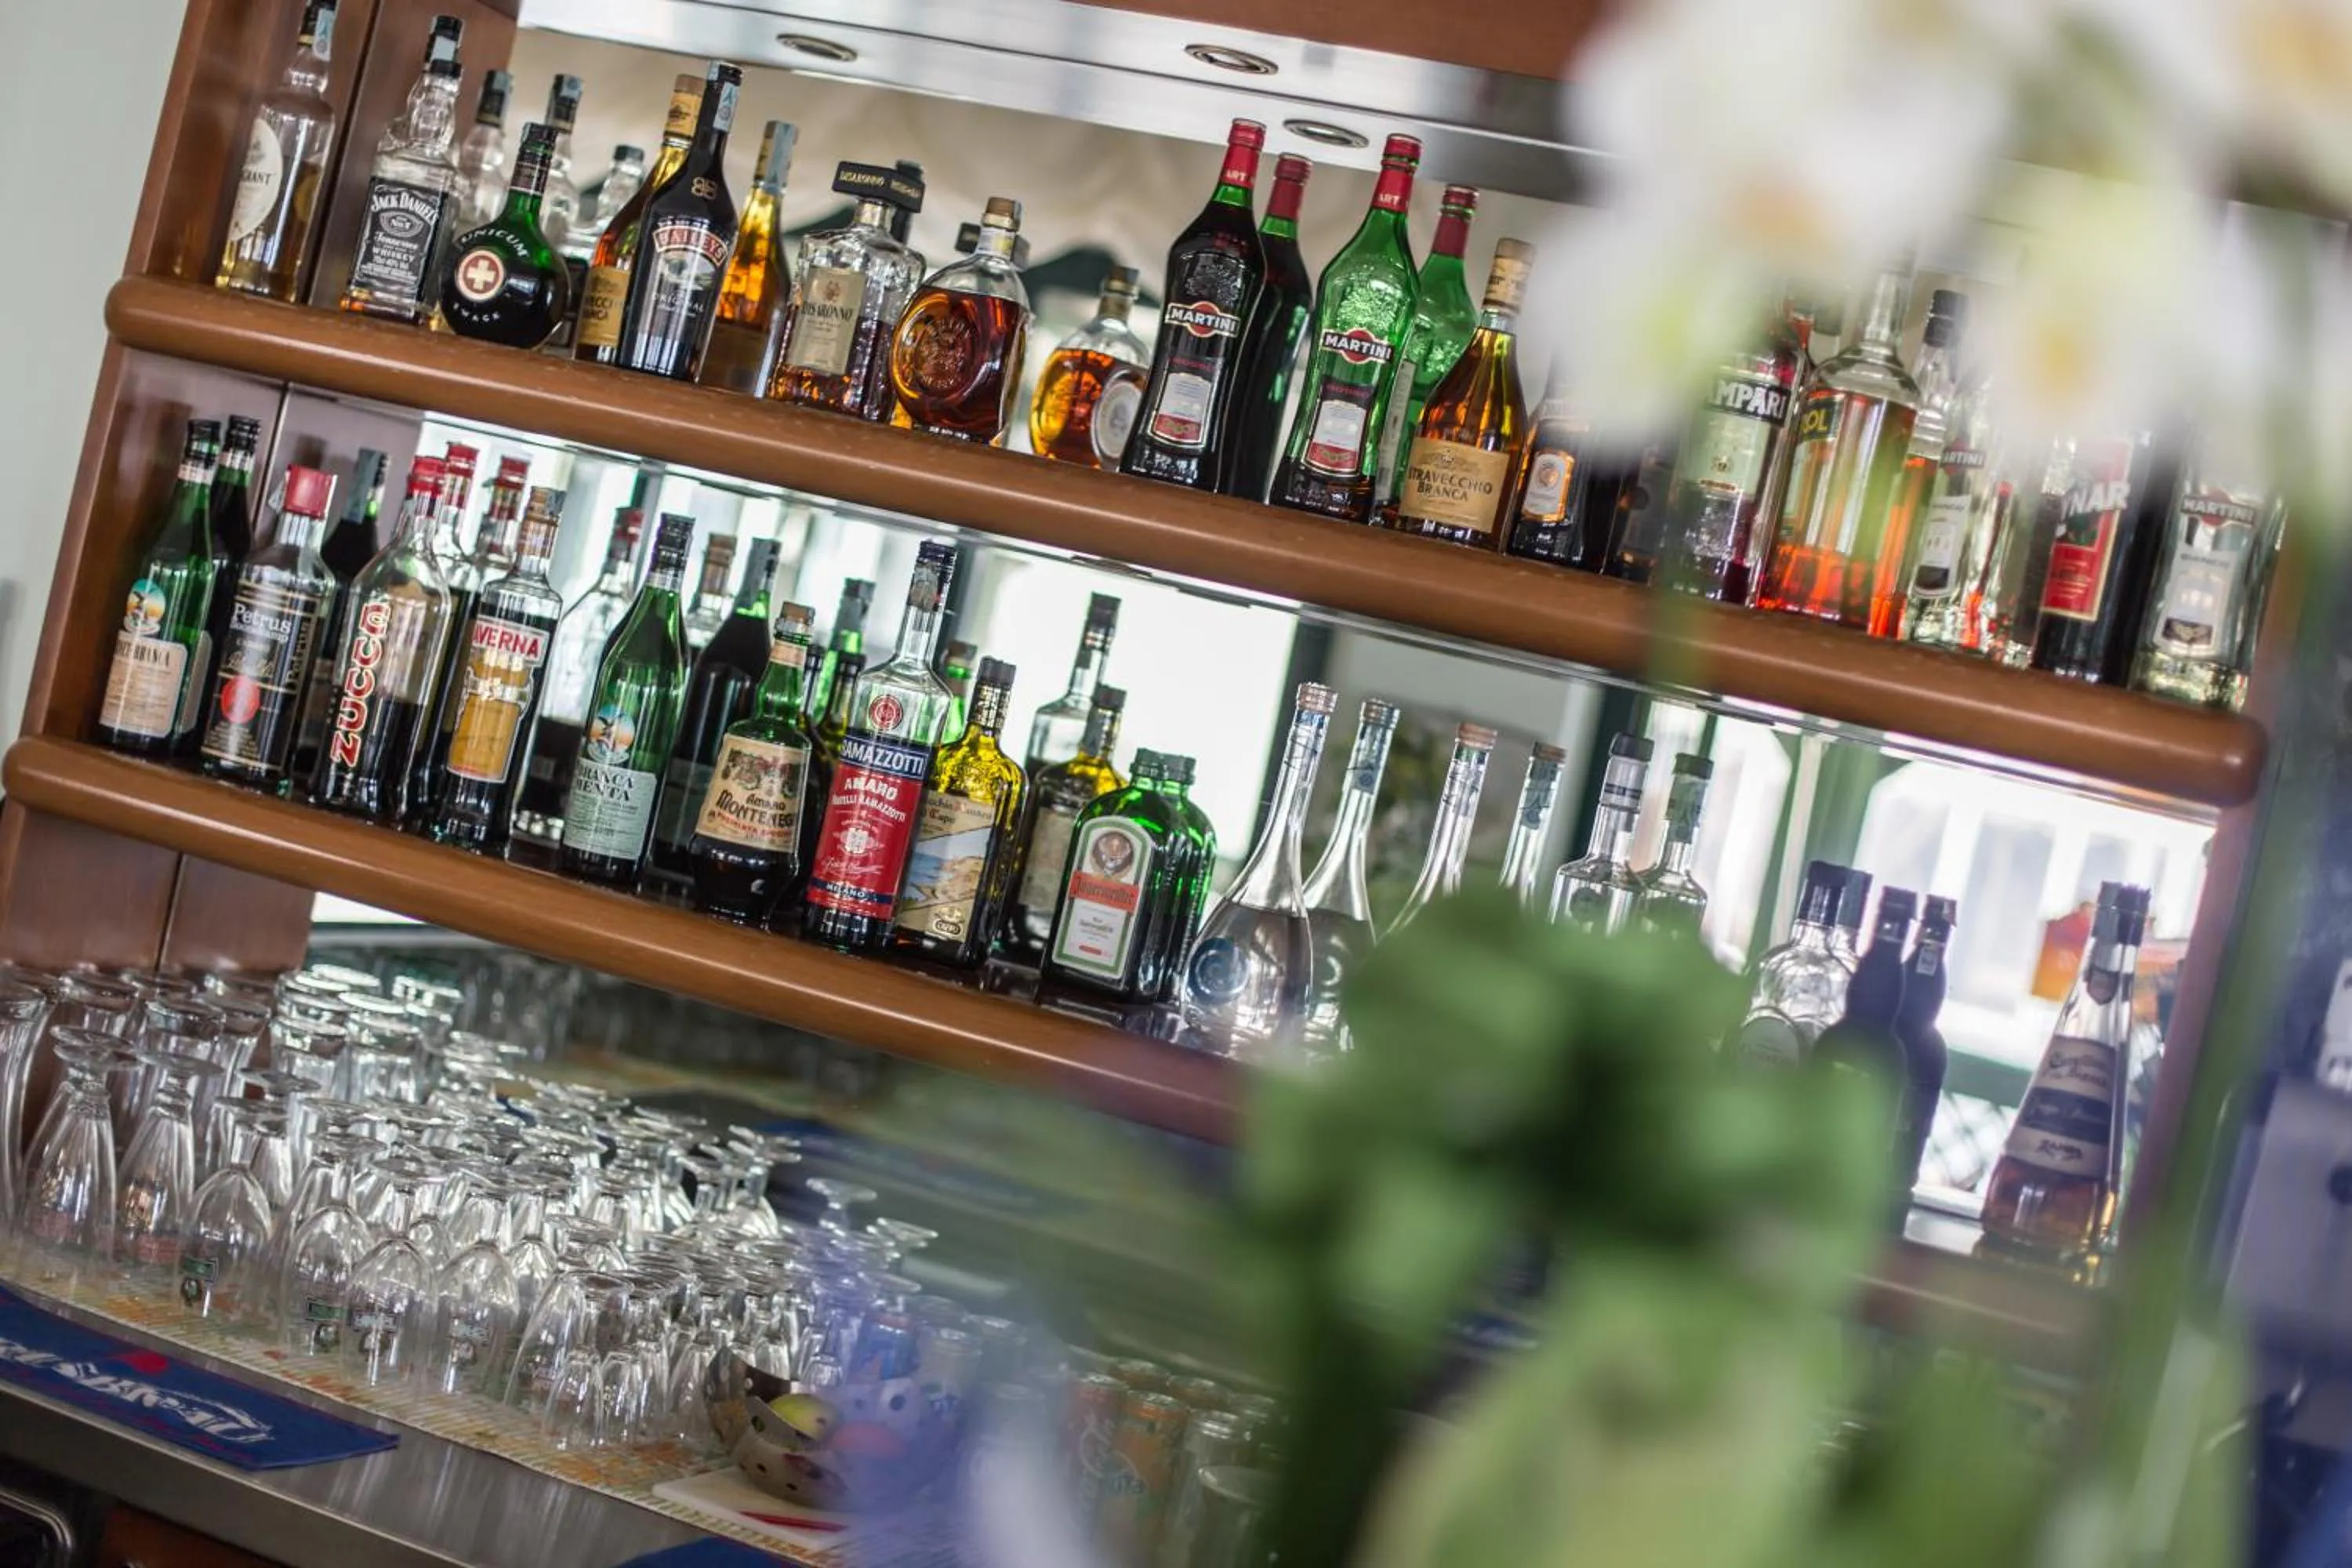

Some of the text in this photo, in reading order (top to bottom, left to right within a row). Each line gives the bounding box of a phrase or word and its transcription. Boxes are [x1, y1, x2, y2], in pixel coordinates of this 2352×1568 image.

[371, 194, 399, 212] JACK
[461, 228, 530, 258] UNICUM
[659, 227, 724, 260] BAILEYS
[802, 301, 854, 323] DISARONNO
[1171, 307, 1237, 332] MARTINI
[1325, 334, 1392, 360] MARTINI
[1715, 379, 1788, 419] MPARI
[1943, 450, 1984, 465] ARTINI
[1408, 466, 1494, 495] TRAVECCHIO
[1417, 481, 1469, 502] BRANCA
[2060, 481, 2131, 521] YNAR
[2183, 499, 2256, 522] MARTINI
[329, 601, 391, 768] ZUCCA
[844, 777, 898, 800] AMARO
[716, 789, 794, 828] MONTENEG
[826, 882, 867, 898] MILANO
